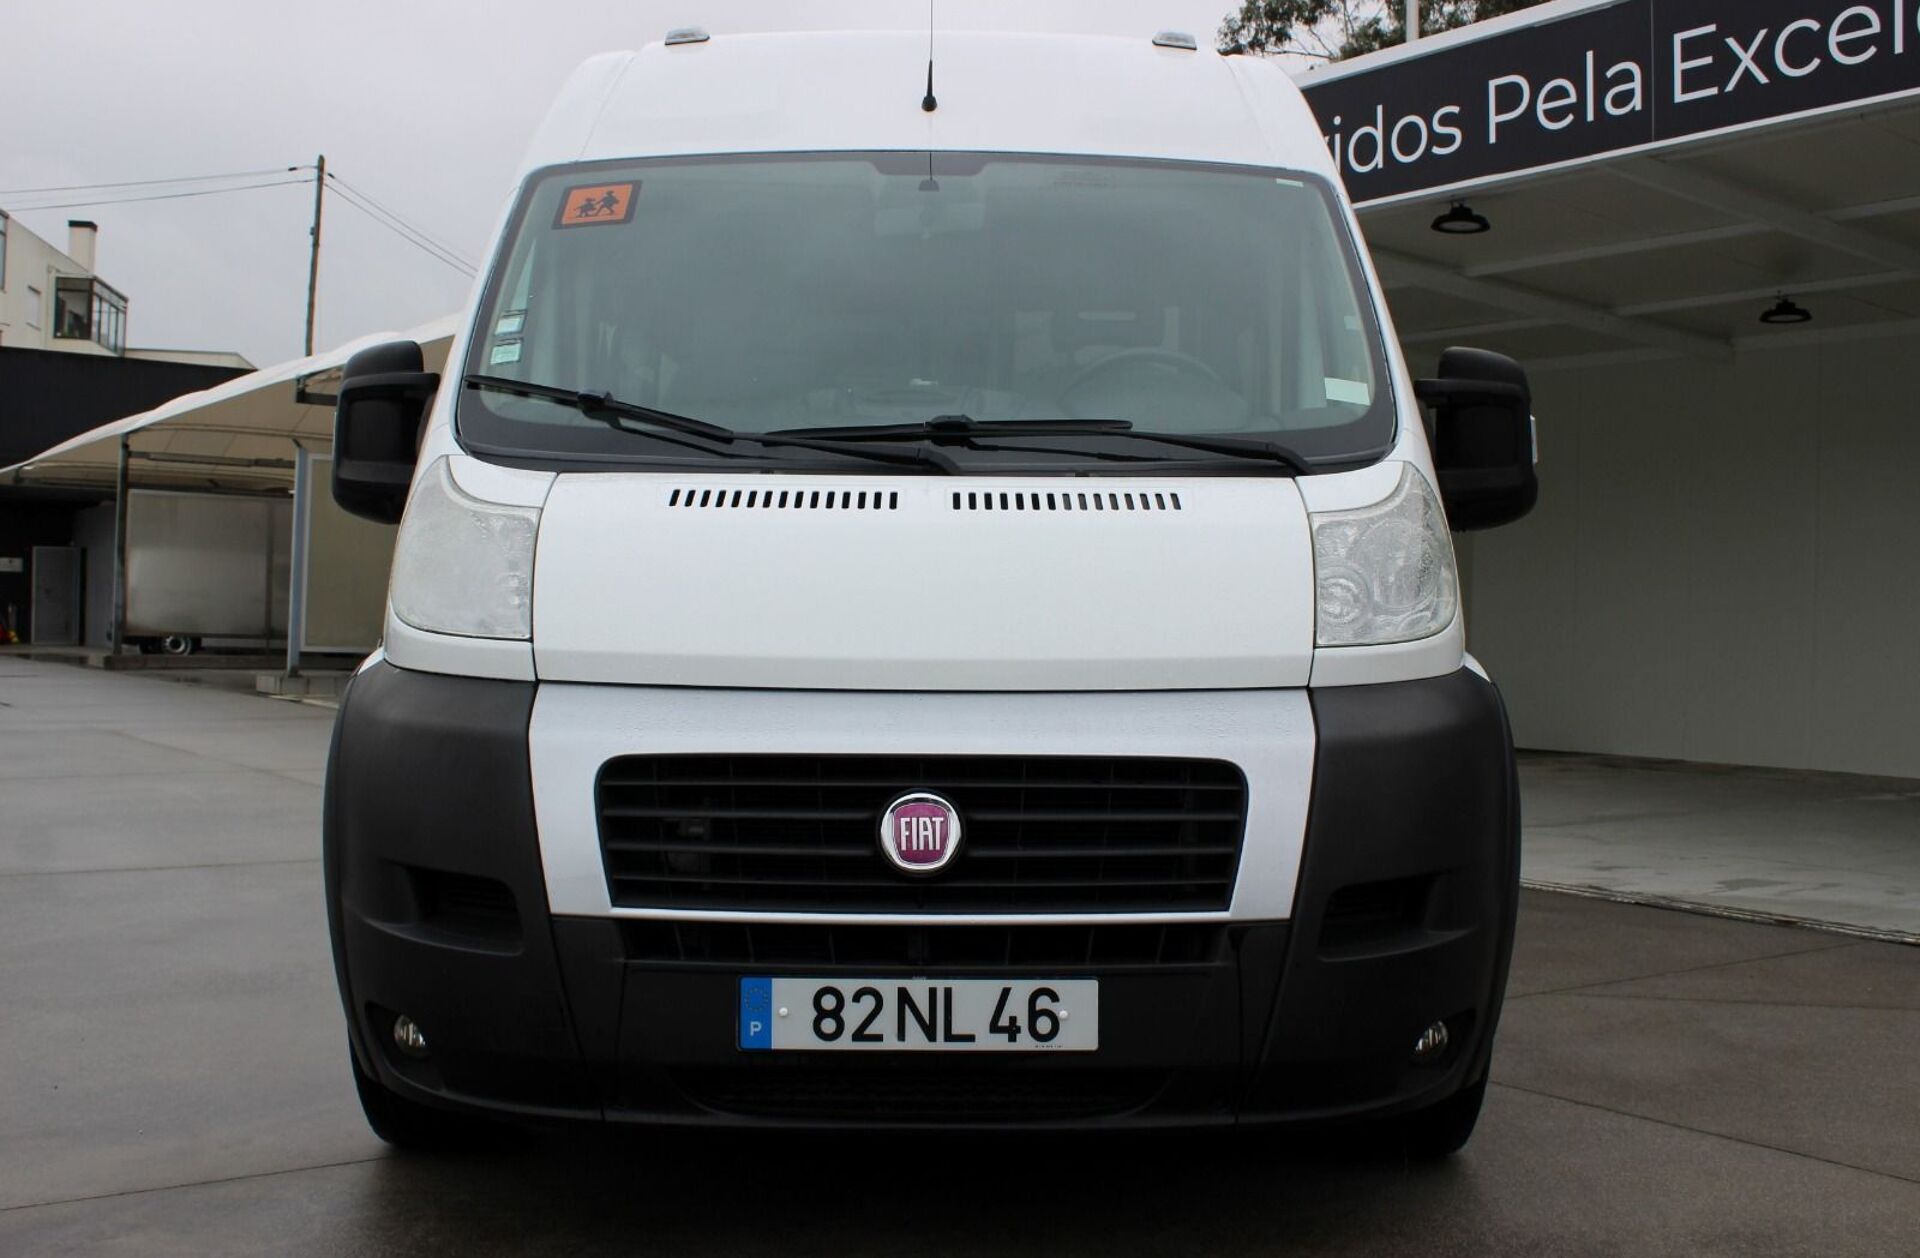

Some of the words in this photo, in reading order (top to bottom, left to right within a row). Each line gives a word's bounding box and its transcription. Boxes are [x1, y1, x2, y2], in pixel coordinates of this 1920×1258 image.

[1324, 104, 1462, 173] idos
[1488, 50, 1643, 144] Pela
[1673, 0, 1920, 103] Excel
[900, 817, 944, 851] FIAT
[750, 1021, 762, 1036] P
